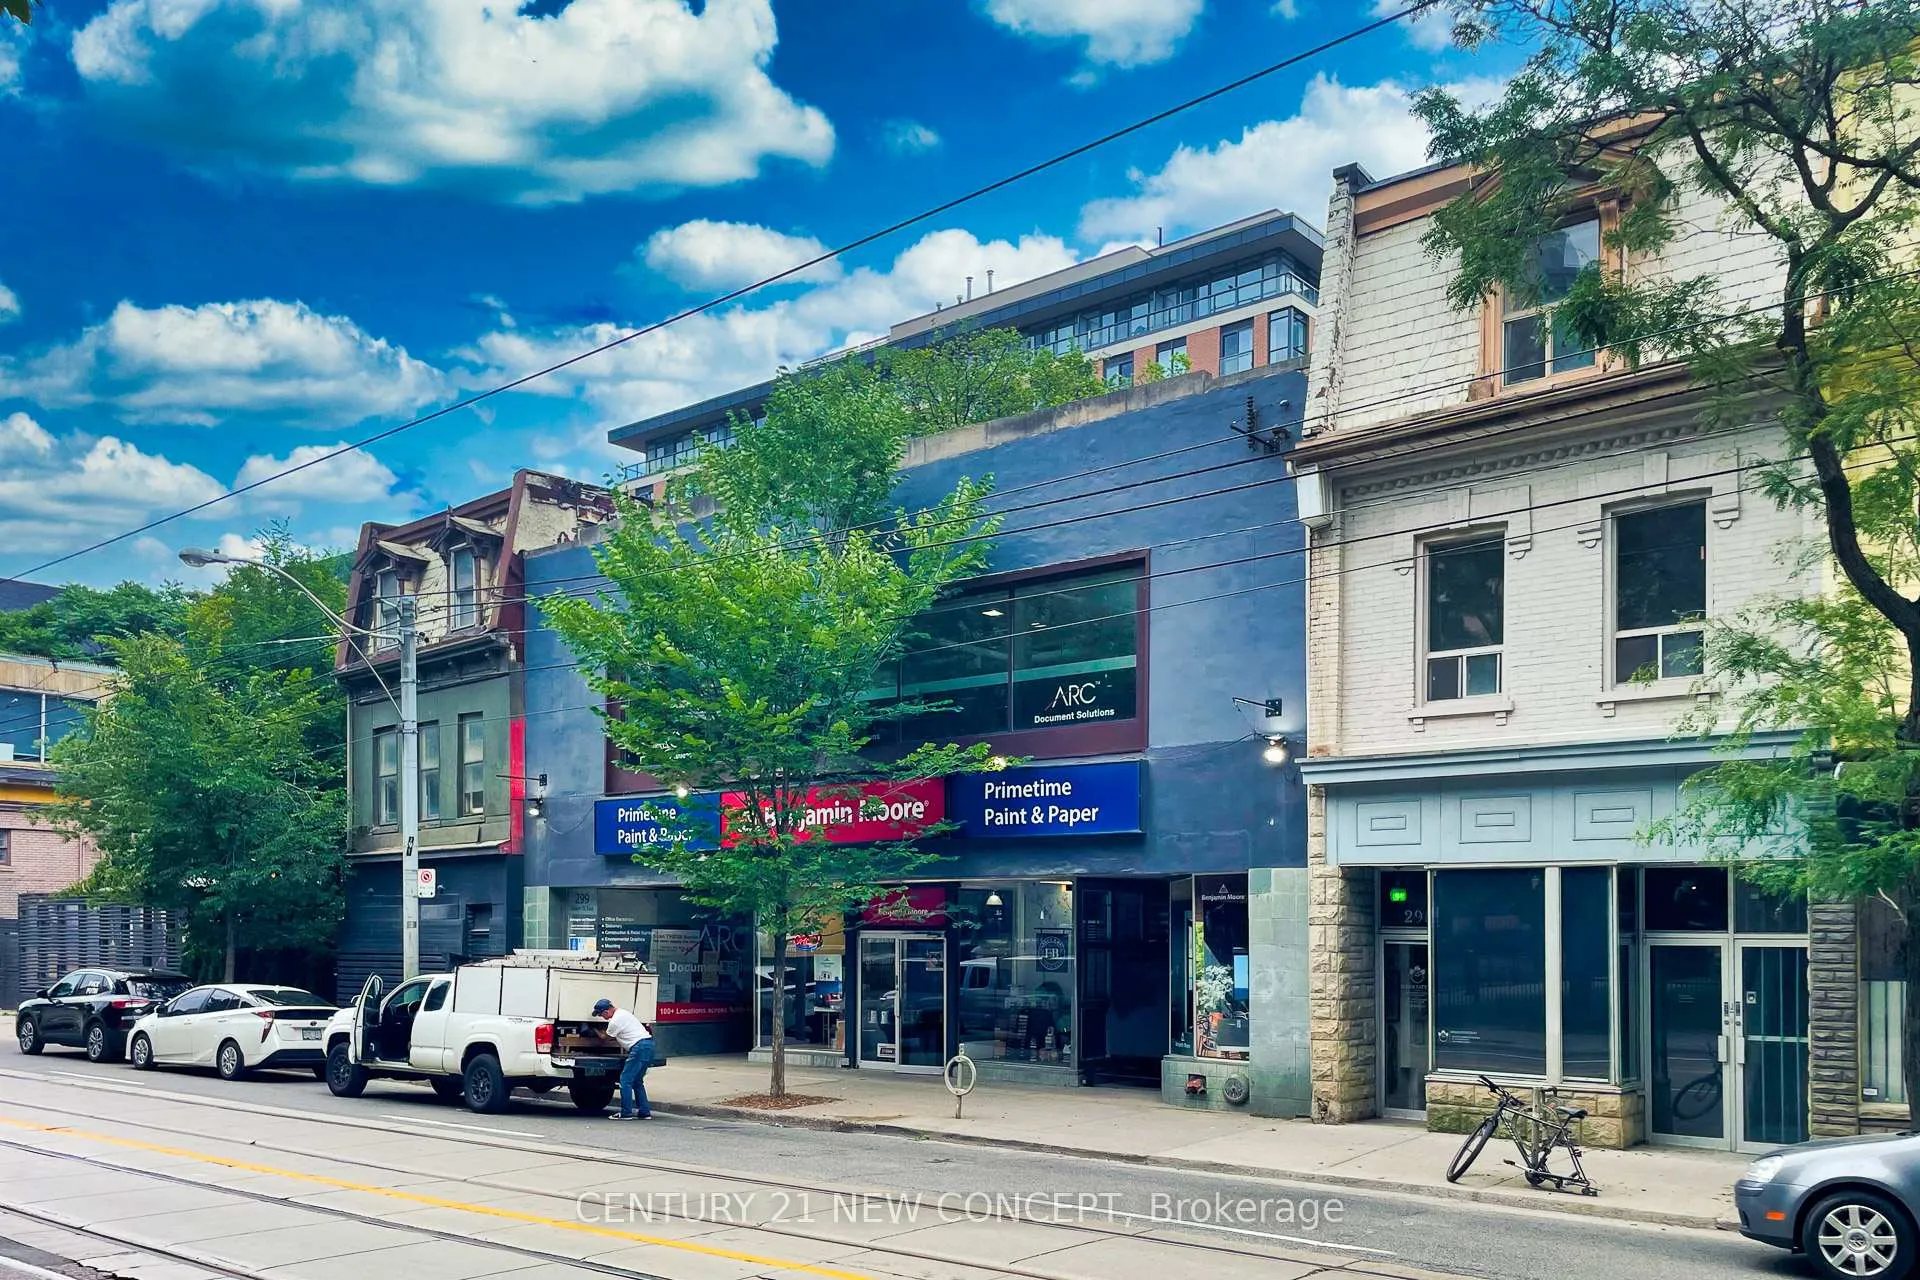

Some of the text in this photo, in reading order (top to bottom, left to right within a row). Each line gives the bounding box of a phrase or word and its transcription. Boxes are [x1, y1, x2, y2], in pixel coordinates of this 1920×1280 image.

[1034, 708, 1116, 724] Document Solutions
[984, 778, 1072, 800] Primetime
[984, 804, 1100, 827] Paint & Paper
[617, 827, 647, 844] Paint
[648, 826, 658, 842] &
